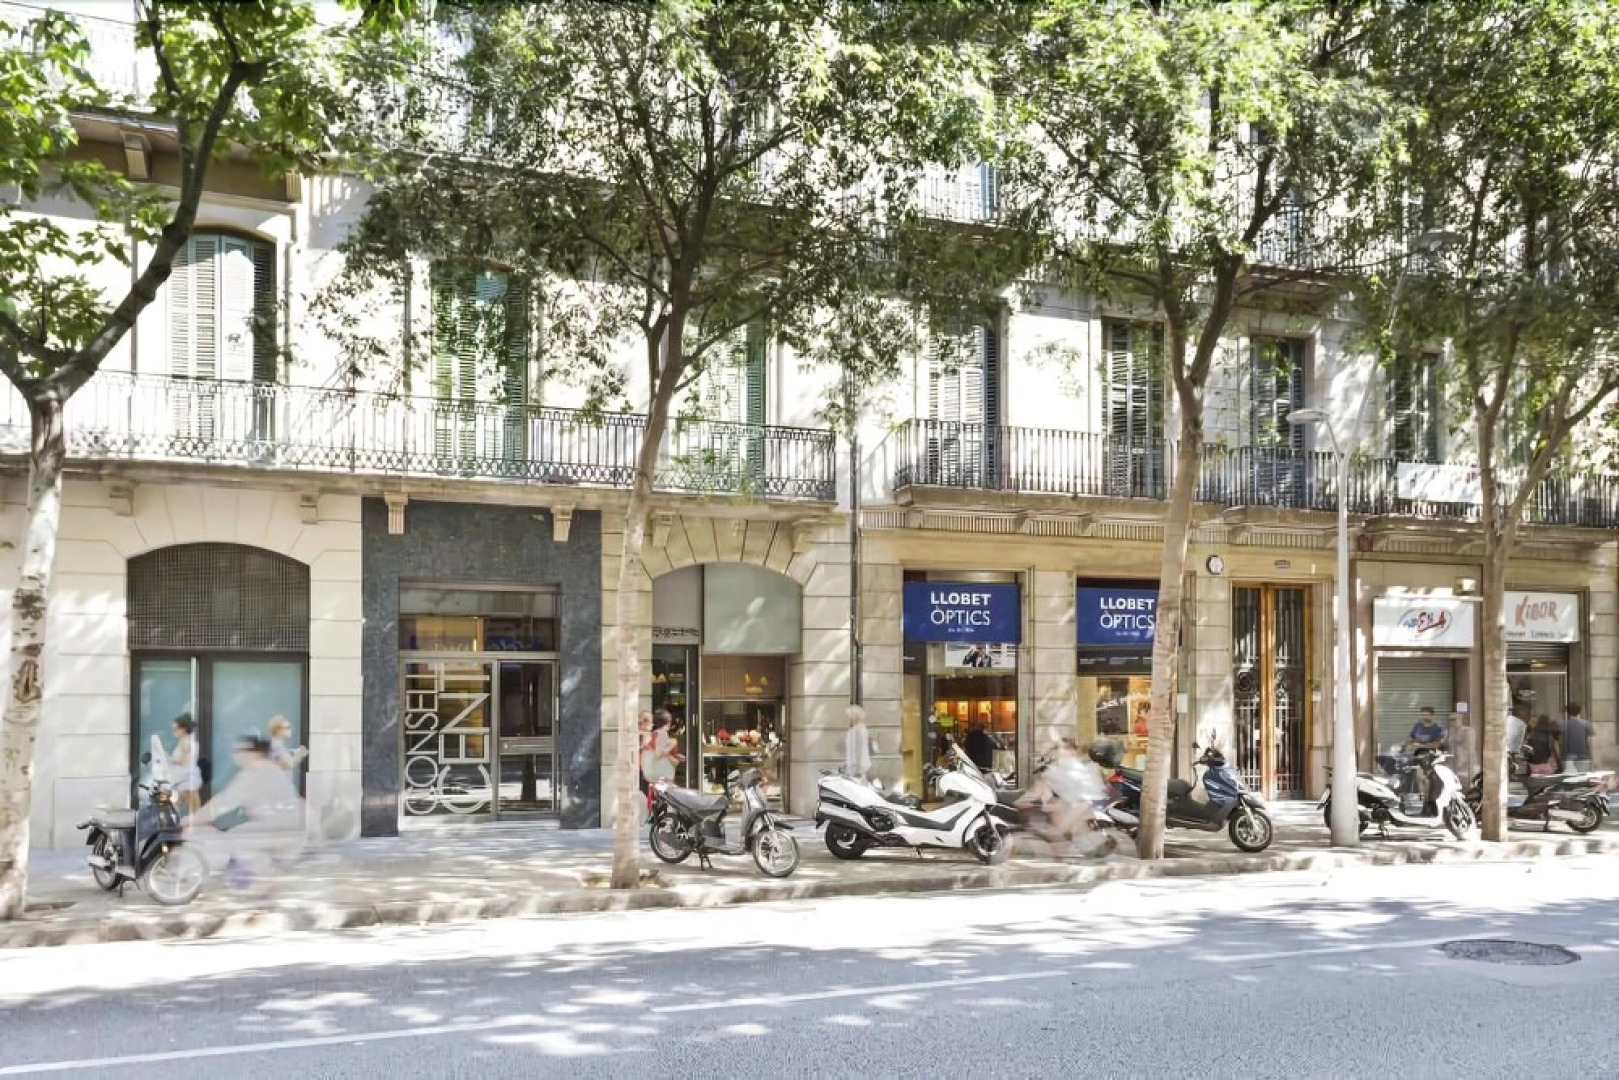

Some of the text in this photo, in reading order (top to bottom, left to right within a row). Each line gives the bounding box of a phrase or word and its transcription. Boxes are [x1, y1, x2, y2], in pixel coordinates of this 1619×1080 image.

[930, 591, 992, 606] LLOBET
[1100, 597, 1155, 610] LLOBET
[930, 605, 991, 626] ÒPTICS
[404, 662, 439, 815] CONSELL
[437, 662, 491, 815] CENT
